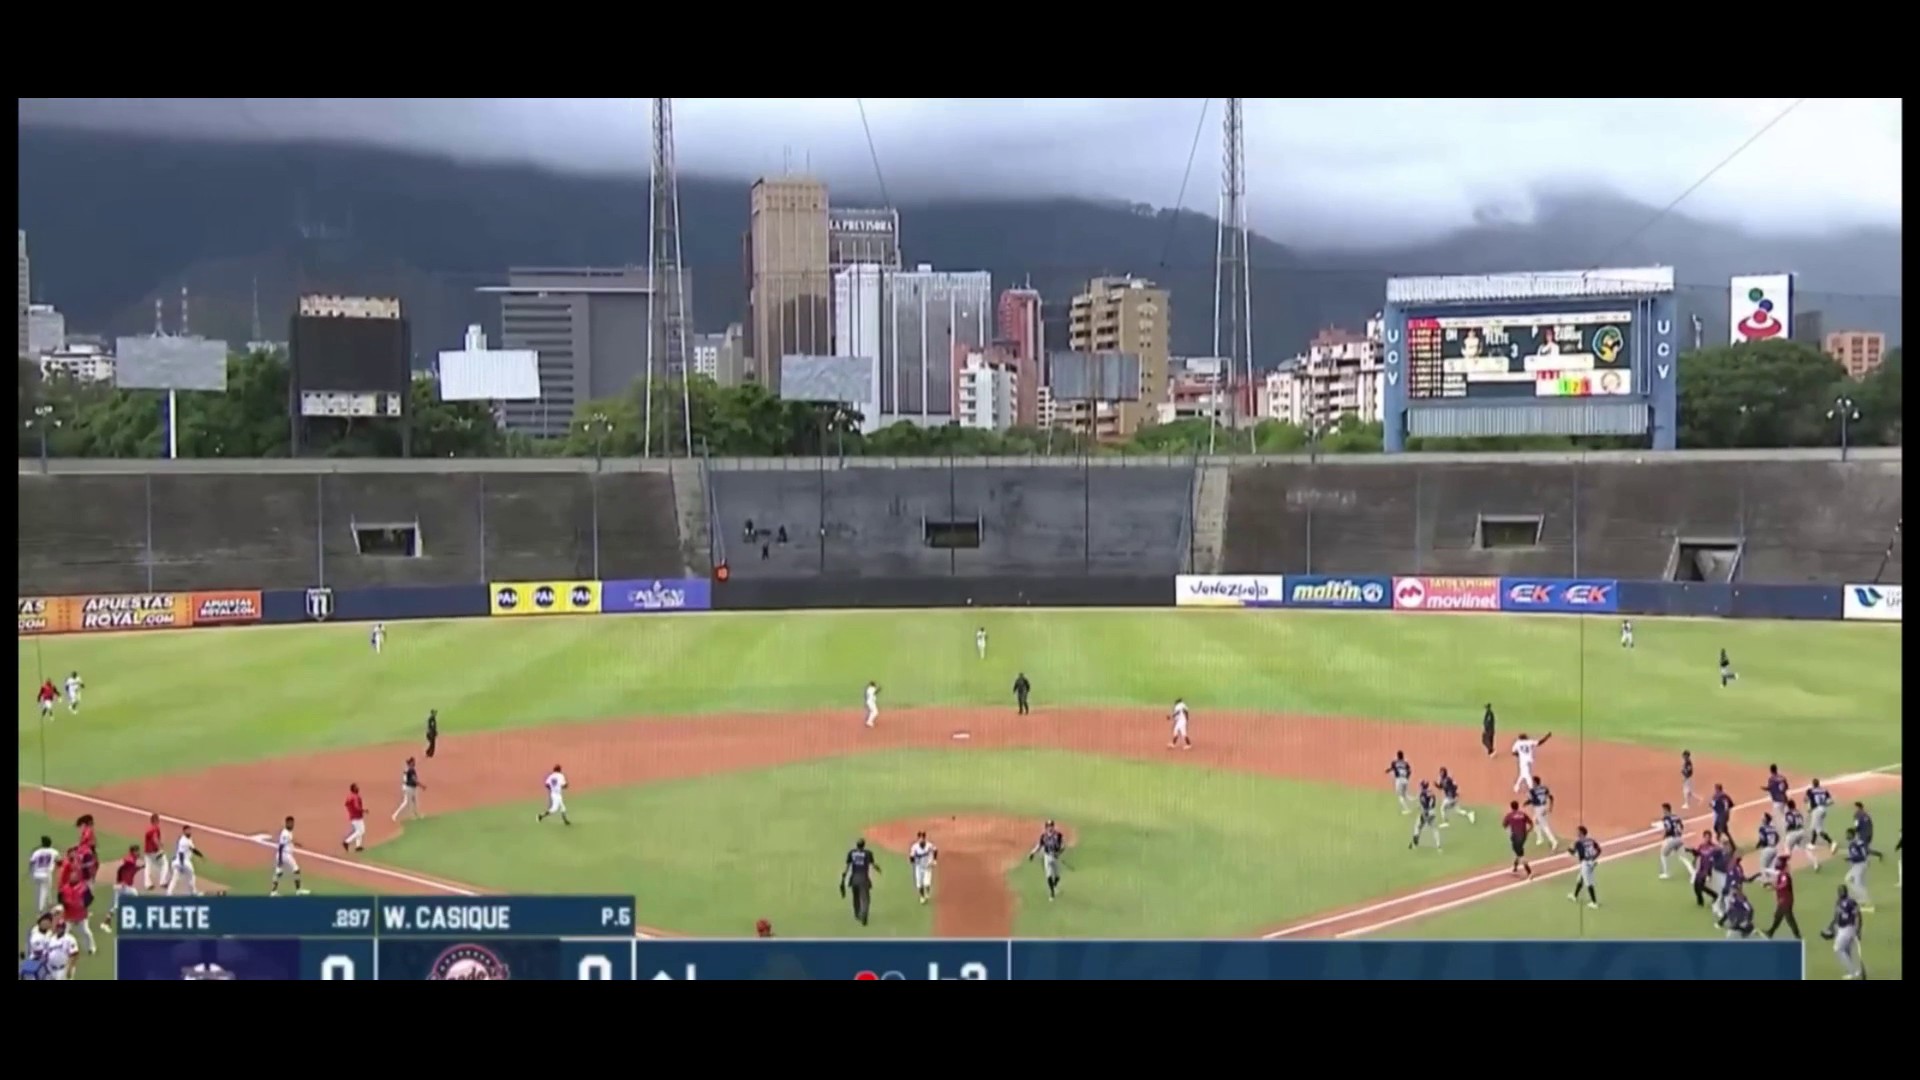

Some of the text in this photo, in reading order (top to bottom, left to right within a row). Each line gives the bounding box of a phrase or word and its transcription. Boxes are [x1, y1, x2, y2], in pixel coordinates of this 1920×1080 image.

[829, 220, 893, 232] LA PREVISORA
[84, 595, 174, 611] APUESTAS
[1426, 592, 1497, 608] movilnet
